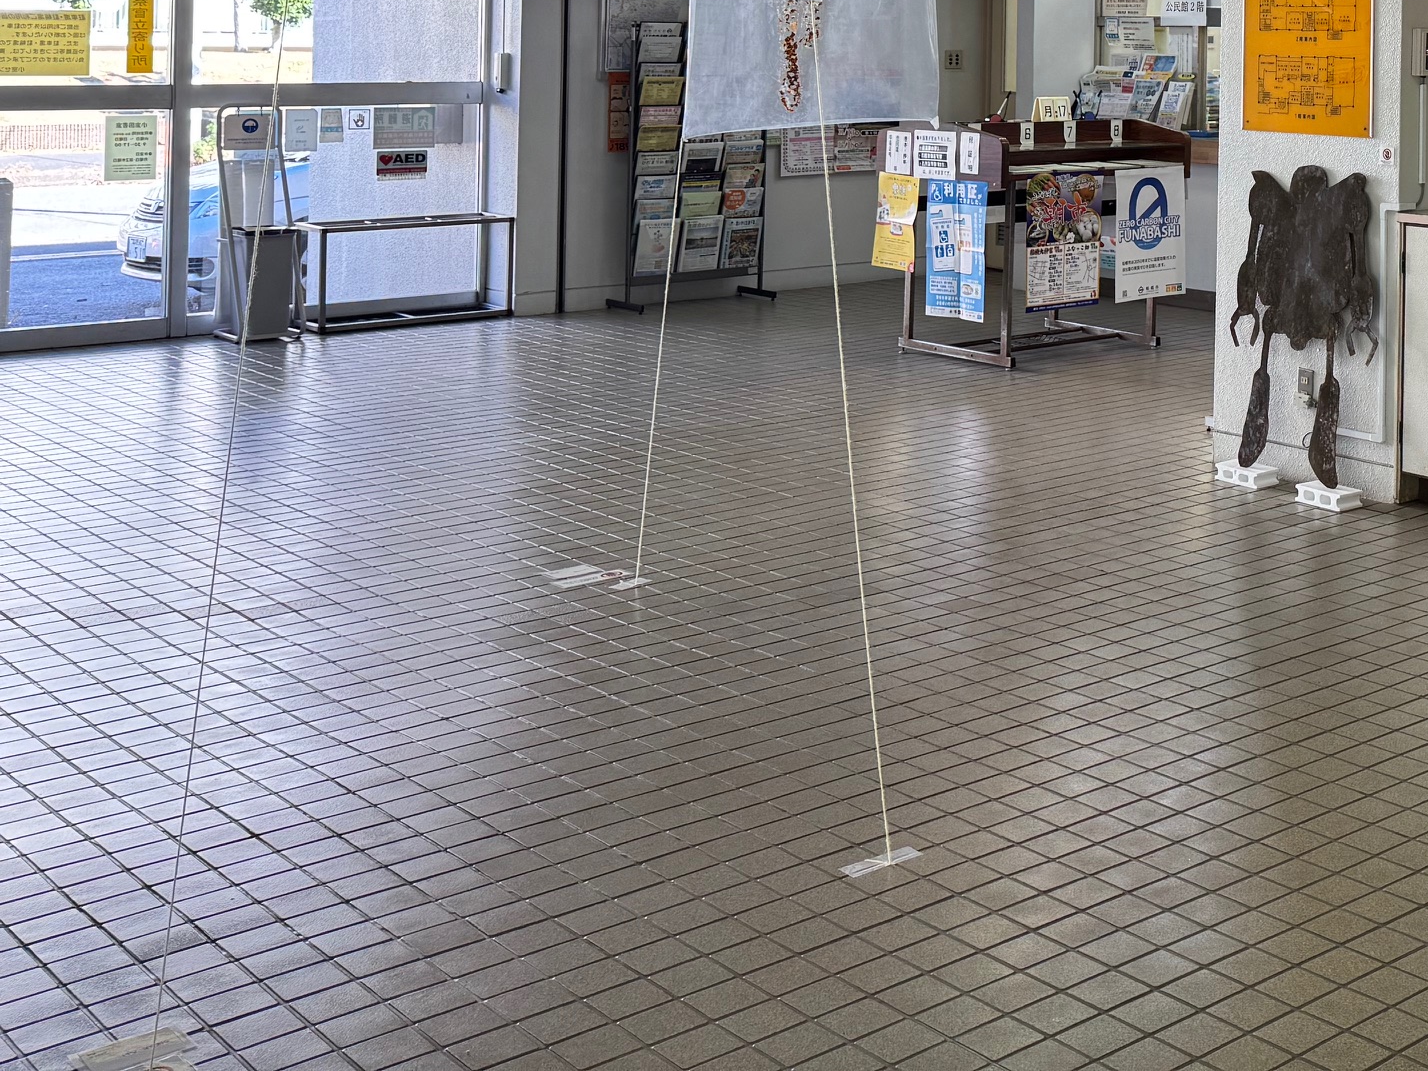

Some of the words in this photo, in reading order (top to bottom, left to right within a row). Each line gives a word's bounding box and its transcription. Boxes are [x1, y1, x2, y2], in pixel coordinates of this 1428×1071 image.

[1165, 0, 1205, 13] 公民館2階
[1024, 127, 1031, 141] 6
[1066, 125, 1073, 137] 7
[1113, 124, 1119, 136] 8
[393, 153, 426, 164] AED
[1163, 214, 1180, 225] CITY
[1117, 223, 1181, 243] FUNABASHI
